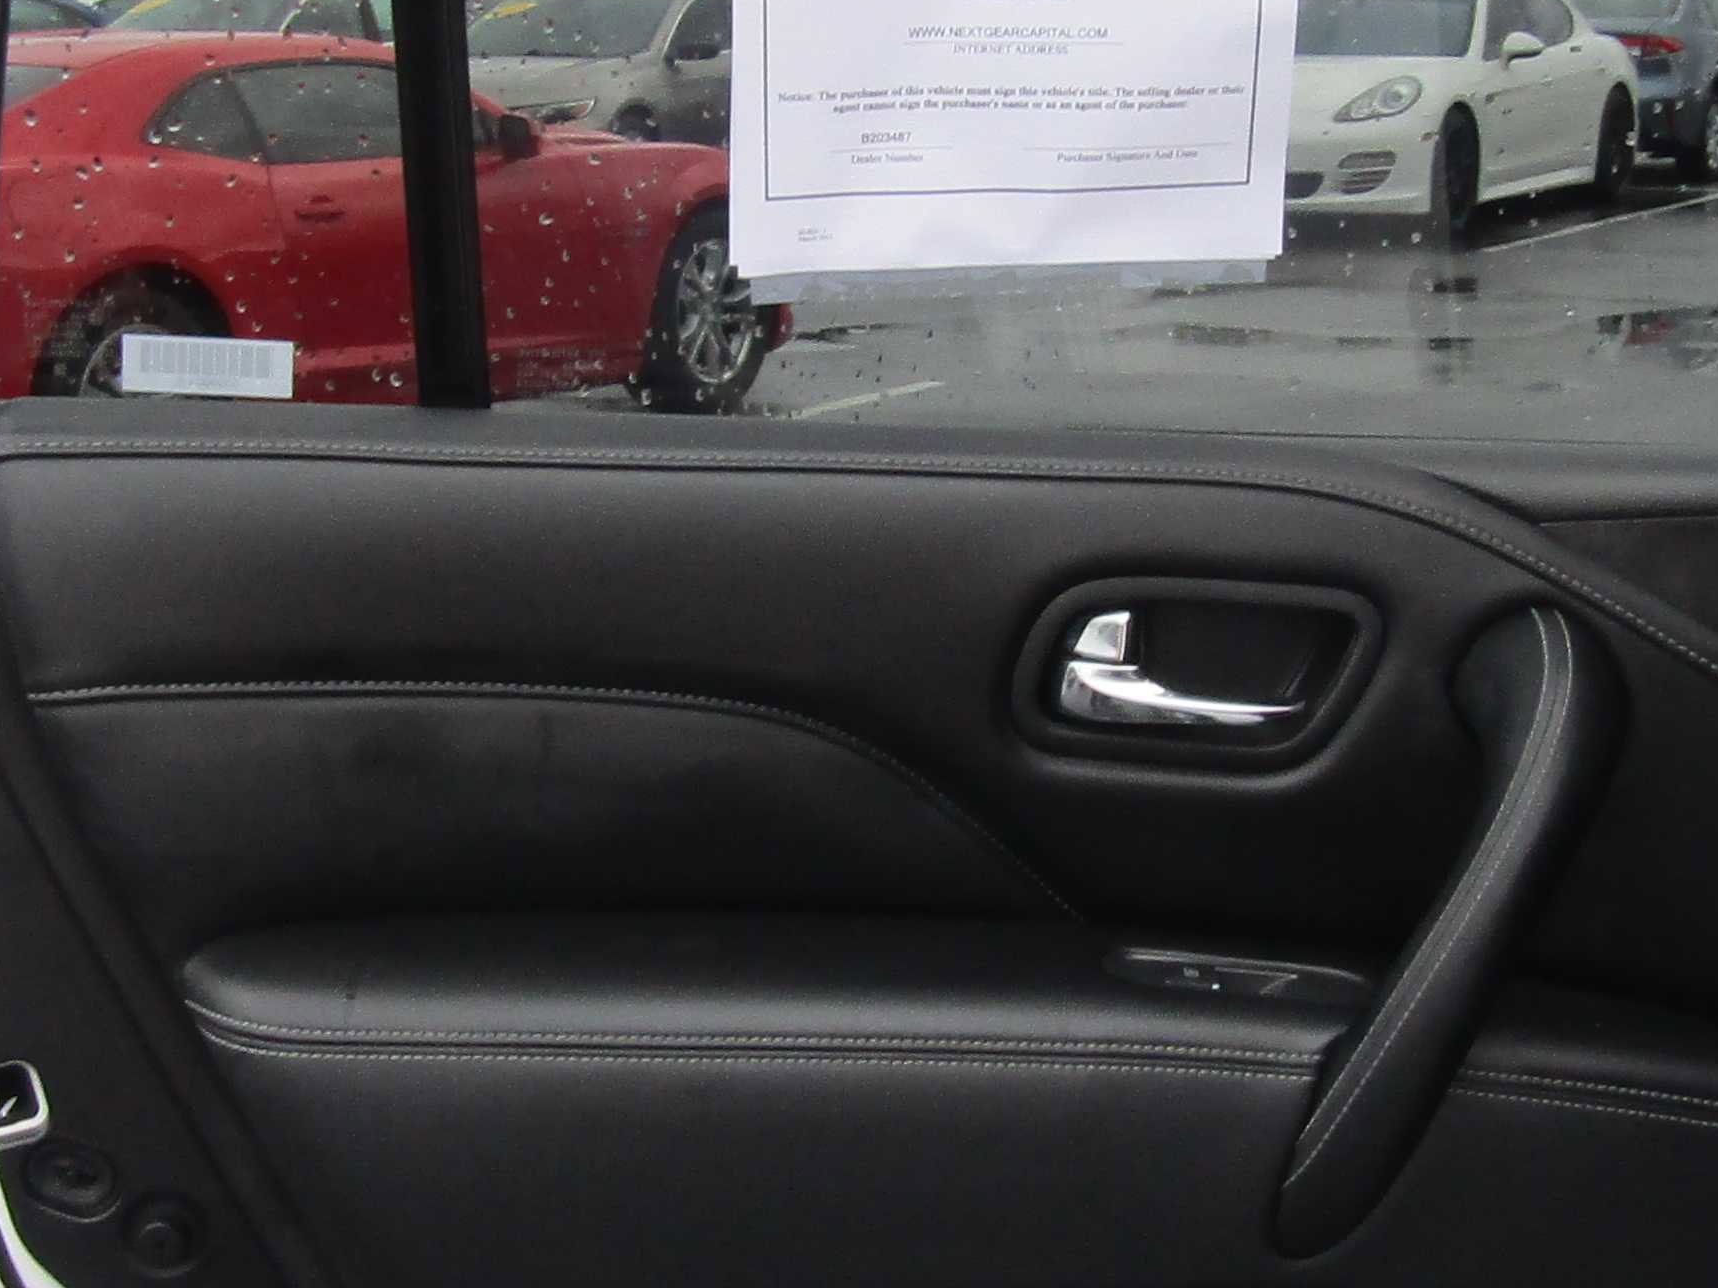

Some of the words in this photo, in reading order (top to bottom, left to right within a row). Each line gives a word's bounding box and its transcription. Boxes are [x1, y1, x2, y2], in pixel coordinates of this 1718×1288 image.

[908, 27, 1108, 39] WWW.NEXTGEARCAPITAL.COM
[954, 44, 1011, 55] INTERNET
[1015, 44, 1069, 55] ADDRESS
[819, 91, 837, 101] The
[840, 88, 888, 101] purchaser
[906, 86, 924, 96] this
[927, 86, 963, 96] vehicle
[967, 87, 991, 96] must
[994, 87, 1015, 98] sign
[1115, 87, 1133, 96] The
[1137, 87, 1171, 98] selling
[1174, 86, 1205, 96] dealer
[863, 101, 896, 111] cannot
[899, 100, 920, 111] sign
[924, 99, 939, 109] the
[1119, 99, 1134, 109] the
[885, 152, 924, 163] Number
[1106, 151, 1151, 162] Signature
[1155, 150, 1172, 160] And
